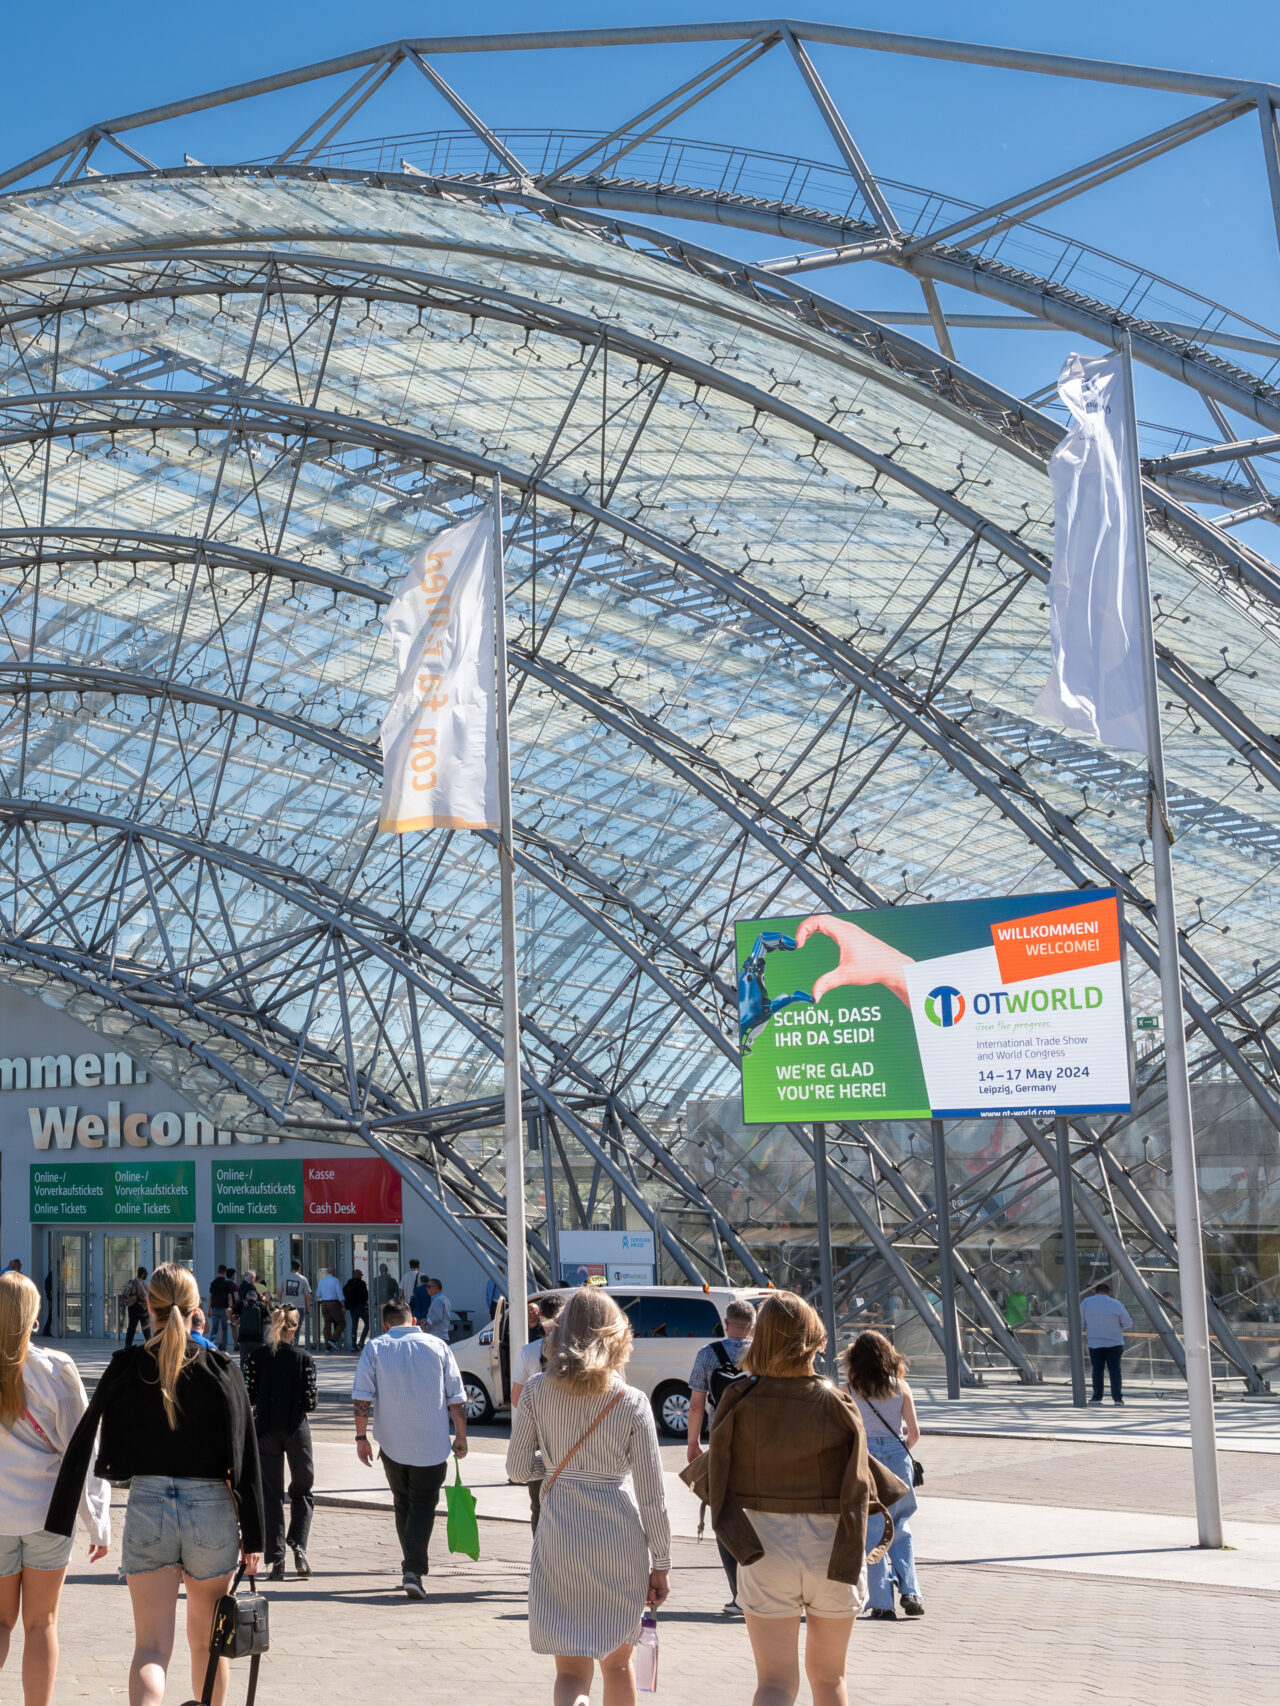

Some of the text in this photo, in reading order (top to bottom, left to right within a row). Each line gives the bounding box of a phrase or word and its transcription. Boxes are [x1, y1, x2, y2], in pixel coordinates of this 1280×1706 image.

[998, 921, 1099, 941] WILLKOMMEN!
[1026, 939, 1100, 956] WELCOME!
[973, 986, 1103, 1015] OTWORLD
[774, 1006, 881, 1027] SCHÖN, DASS
[976, 1022, 994, 1032] Join
[998, 1020, 1010, 1030] the
[775, 1027, 875, 1047] IHR DA SEID!
[976, 1035, 1088, 1049] International Trade Show
[977, 1049, 1066, 1061] and World Congress
[830, 1062, 874, 1078] GLAD
[1026, 1068, 1052, 1081] May
[1056, 1066, 1090, 1079] 2024
[839, 1082, 887, 1099] HERE!
[979, 1083, 1057, 1095] Leipzig, Germany
[34, 1171, 67, 1183] Online-/
[115, 1170, 149, 1182] Online-/
[217, 1168, 253, 1180] Online-/
[309, 1168, 335, 1180] Kasse
[34, 1184, 104, 1196] Vorverkaufstickets
[115, 1183, 188, 1196] Vorverkaufstickets
[217, 1182, 296, 1195] Vorverkaufstickets
[34, 1202, 87, 1214] Online Tickets
[115, 1202, 170, 1214] Online Tickets
[217, 1202, 277, 1214] Online Tickets
[309, 1202, 356, 1214] Cash Desk
